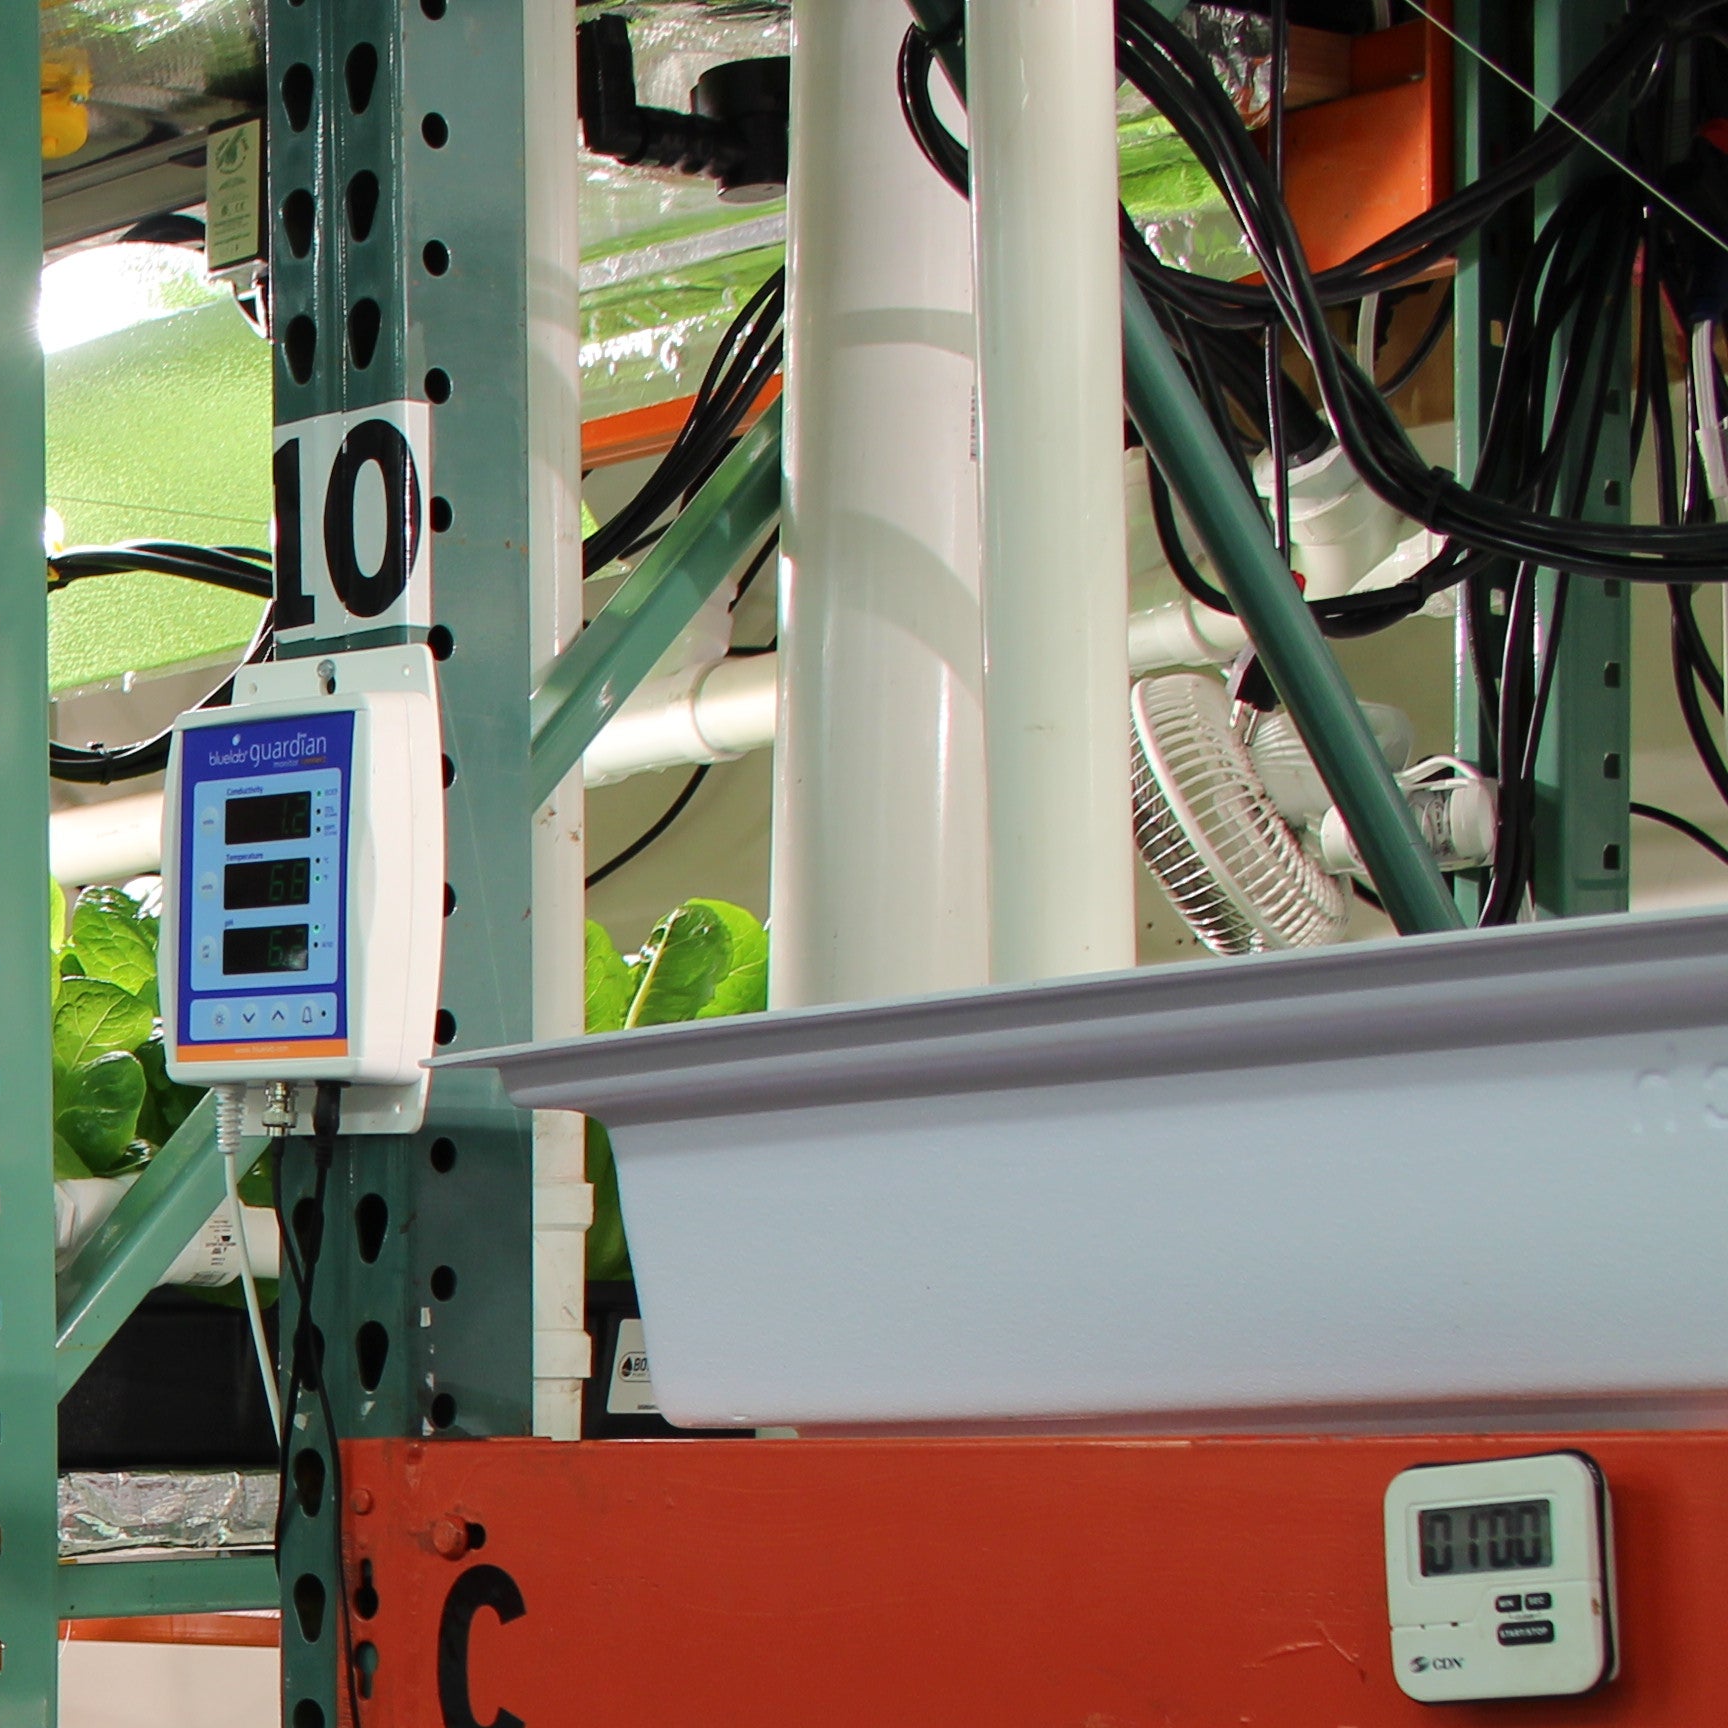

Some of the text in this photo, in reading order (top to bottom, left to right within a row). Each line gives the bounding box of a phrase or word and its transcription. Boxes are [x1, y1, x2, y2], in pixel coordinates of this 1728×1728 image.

[274, 417, 422, 631] 10
[249, 732, 327, 767] guardian
[226, 784, 264, 796] Conductivity
[225, 852, 264, 862] Temperature
[268, 862, 307, 901] 68
[1432, 1658, 1462, 1671] CDN
